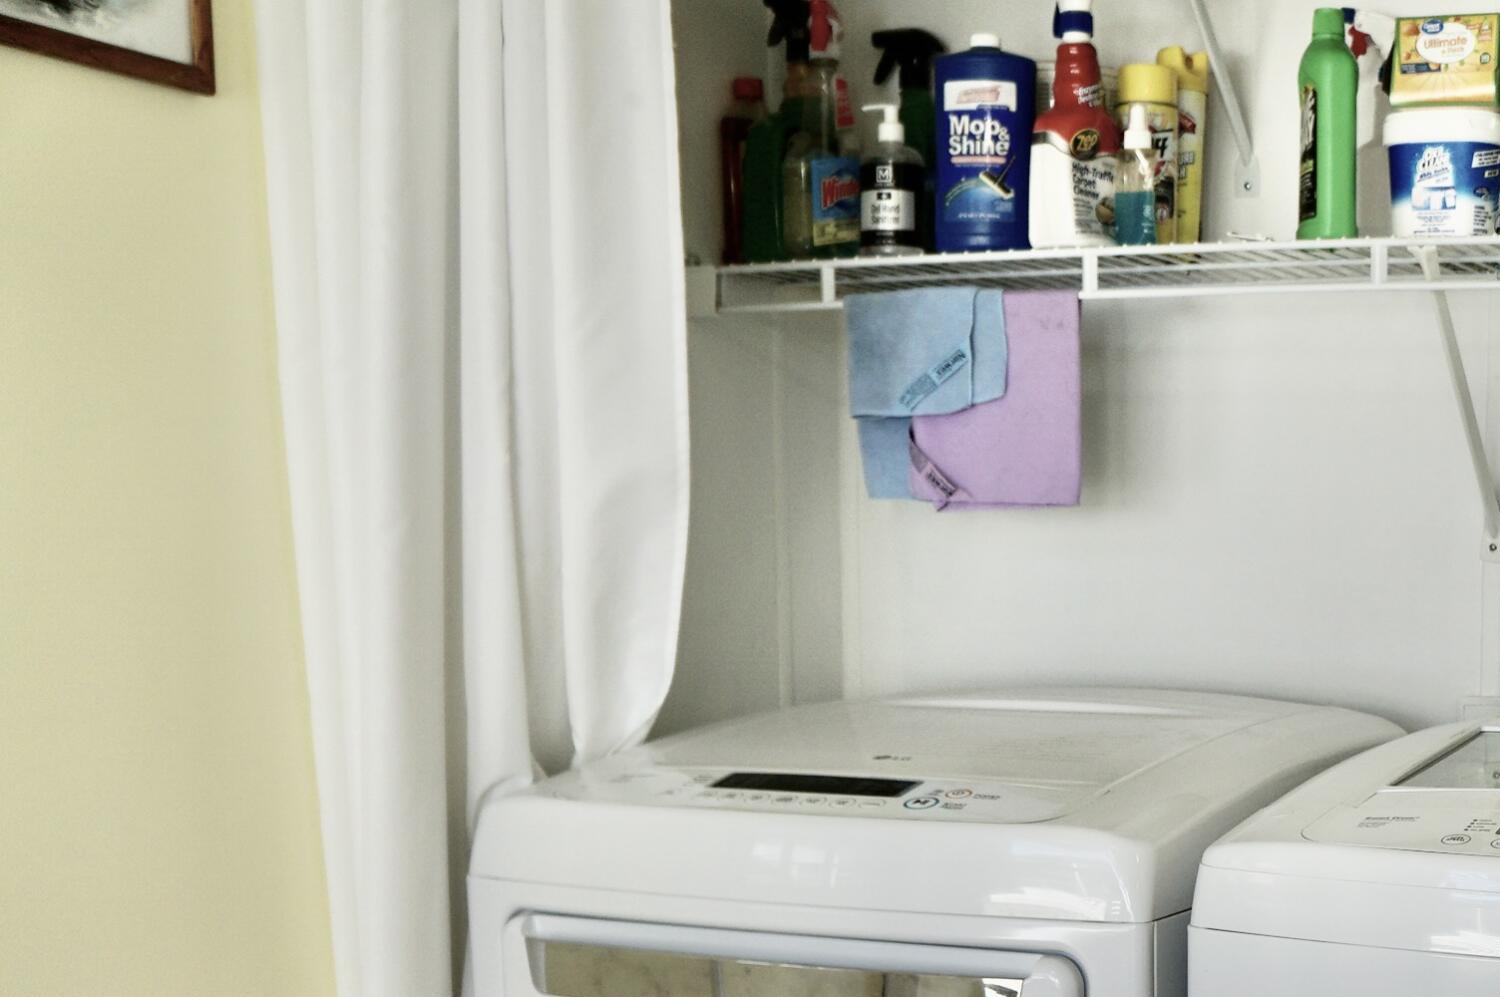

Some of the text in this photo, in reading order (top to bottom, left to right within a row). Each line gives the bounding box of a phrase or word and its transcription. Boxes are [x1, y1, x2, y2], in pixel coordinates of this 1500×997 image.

[1424, 36, 1467, 50] Ultimate
[949, 113, 1001, 143] Mop
[948, 134, 1010, 156] Shine
[1072, 174, 1097, 190] Carpet
[1073, 185, 1100, 200] Cleaner
